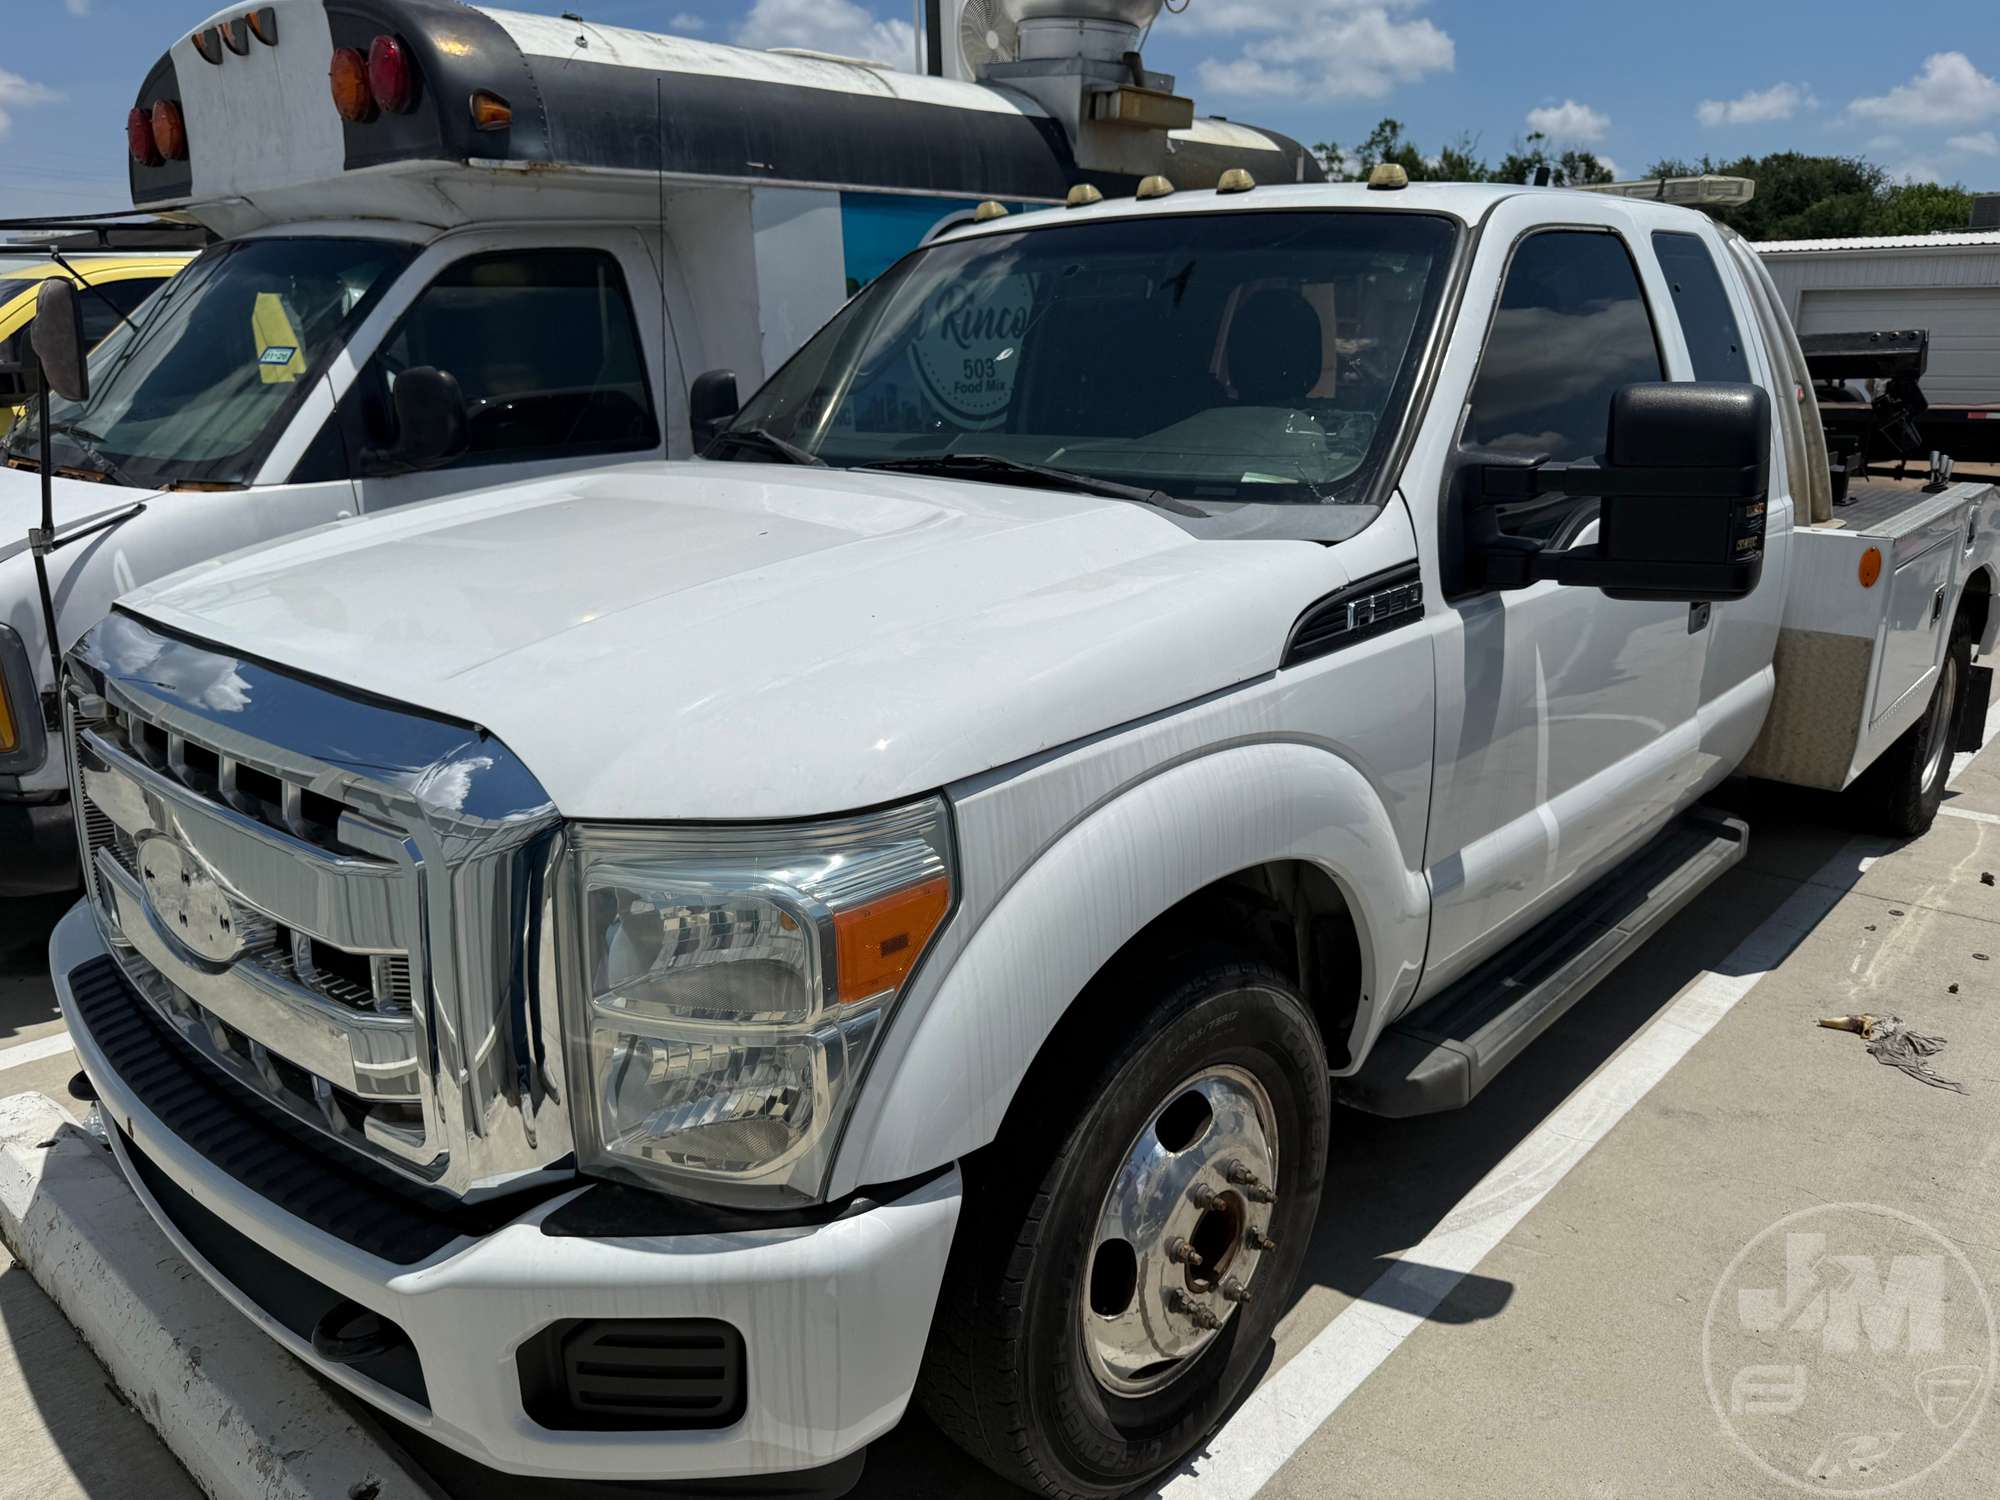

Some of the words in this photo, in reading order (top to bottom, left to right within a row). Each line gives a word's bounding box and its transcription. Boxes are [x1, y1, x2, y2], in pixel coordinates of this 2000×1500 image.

[936, 284, 1027, 349] Rinco
[963, 358, 996, 380] 503
[954, 381, 983, 394] Food
